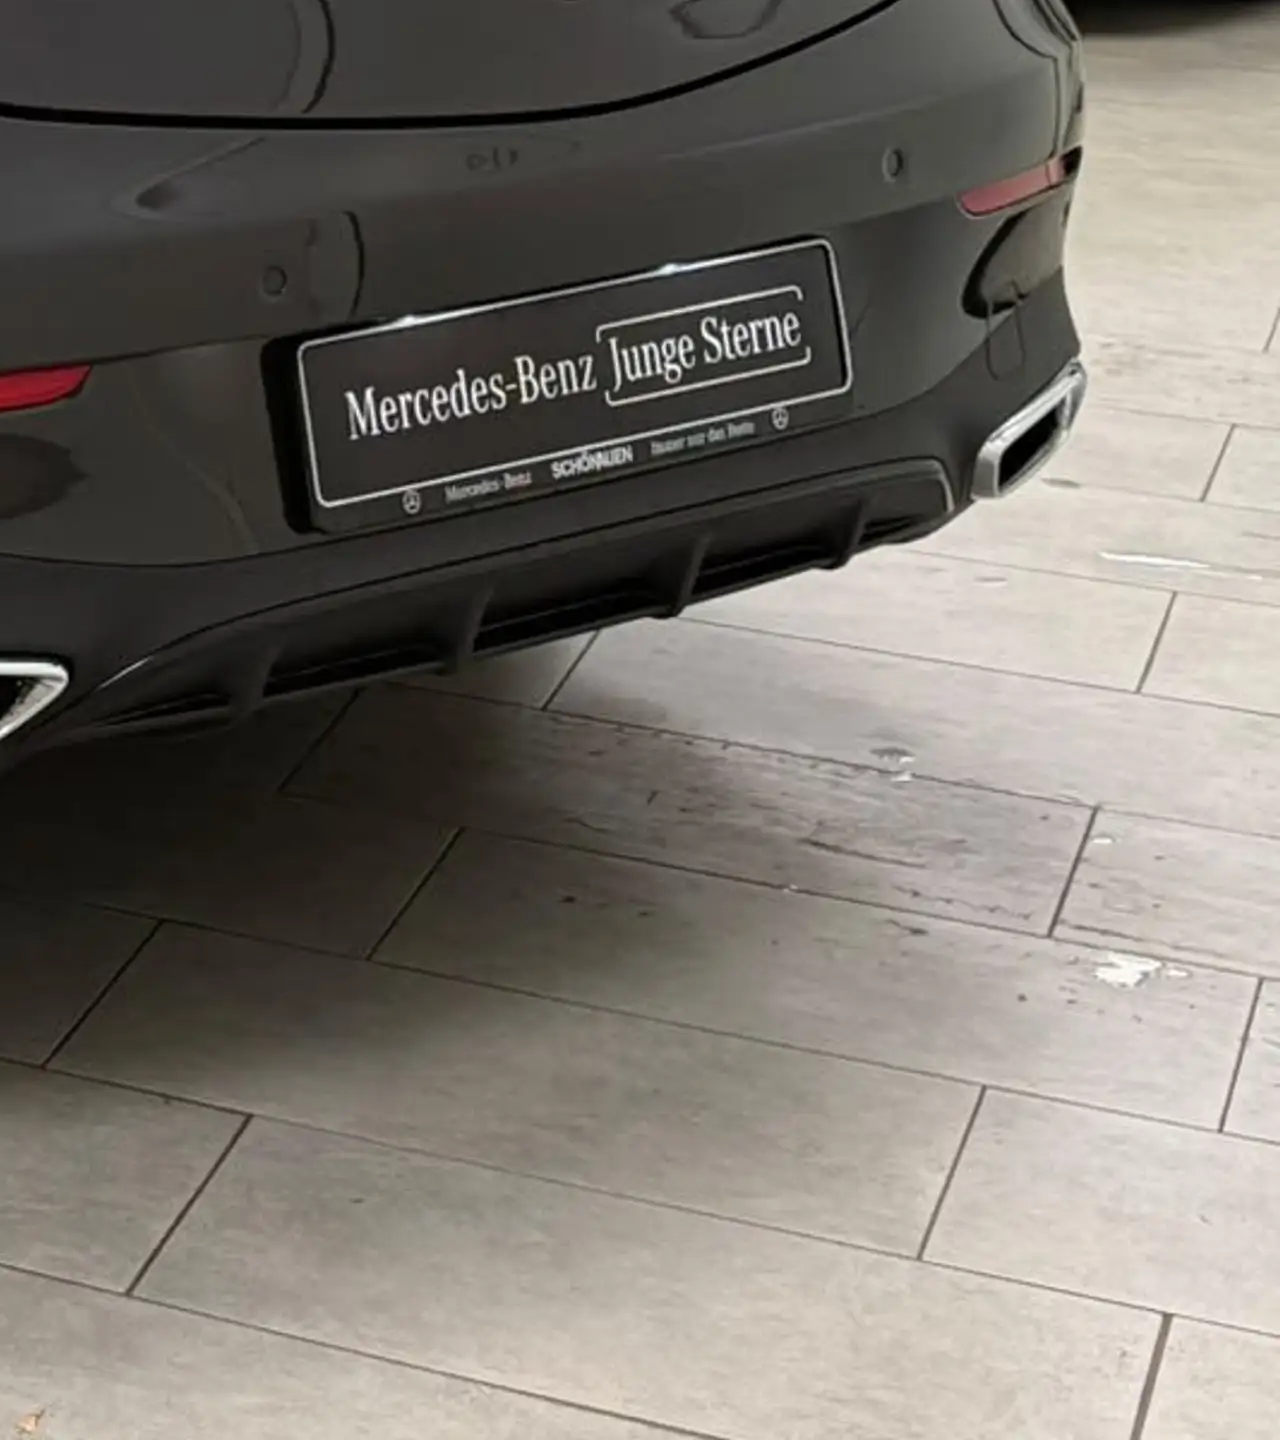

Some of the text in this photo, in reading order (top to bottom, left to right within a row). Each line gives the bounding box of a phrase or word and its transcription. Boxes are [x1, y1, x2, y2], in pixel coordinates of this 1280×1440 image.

[344, 310, 802, 442] Mercedes-Benz Junge Sterne
